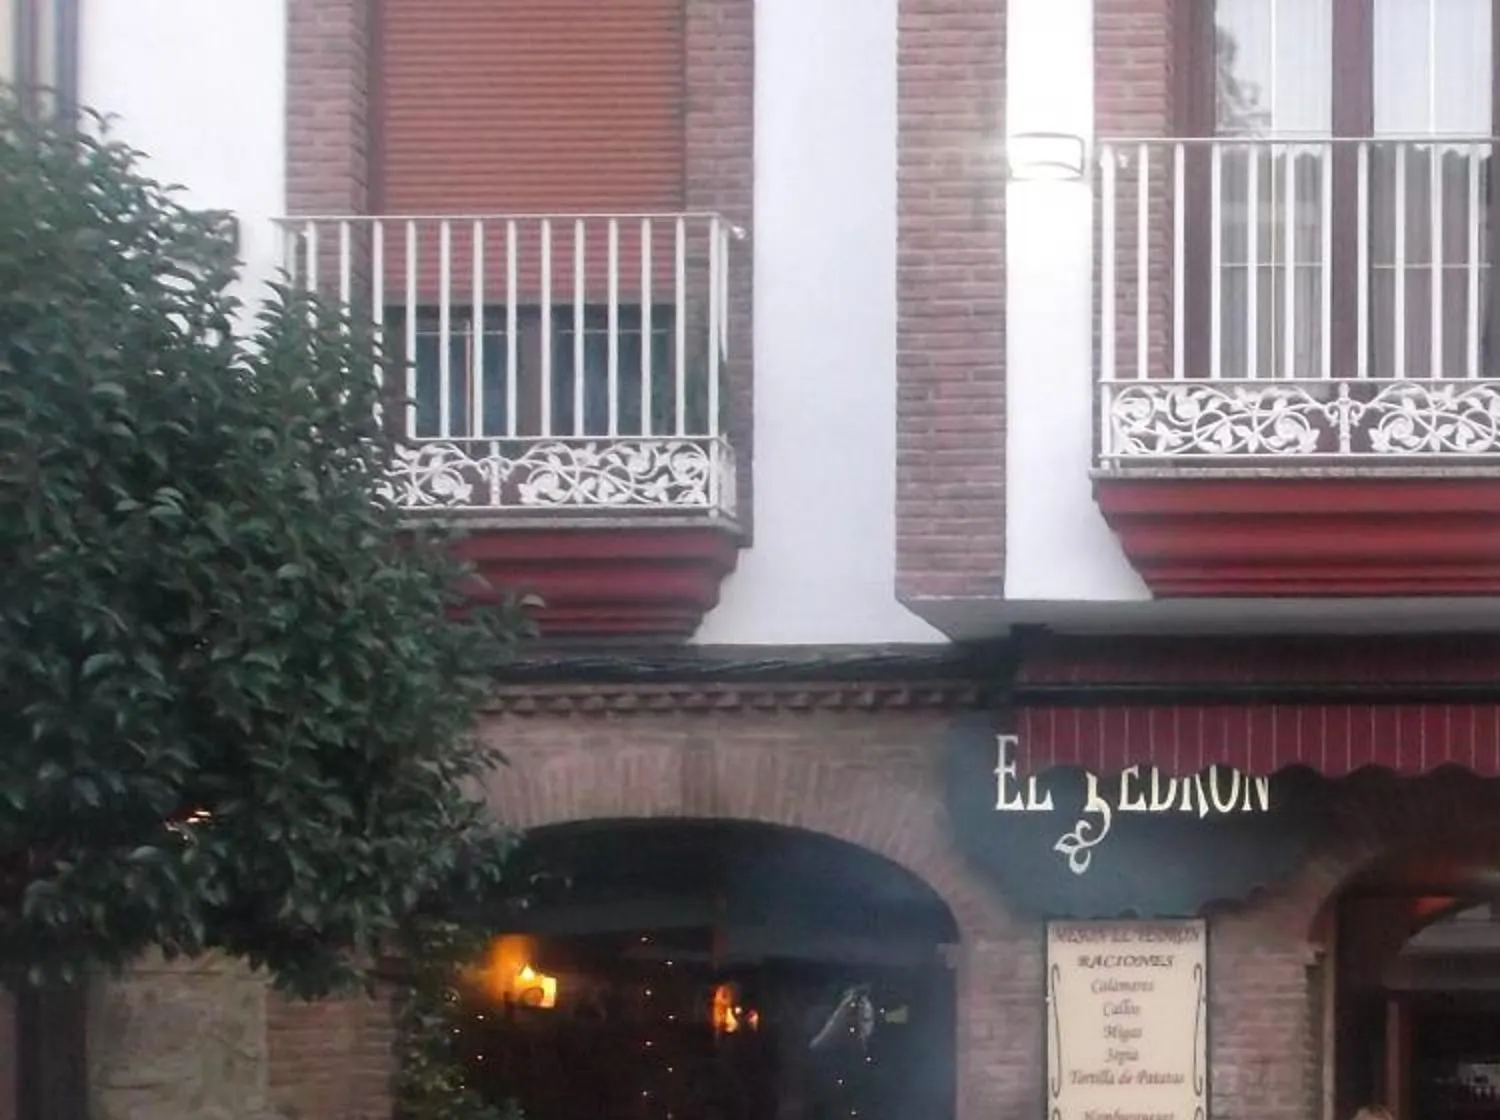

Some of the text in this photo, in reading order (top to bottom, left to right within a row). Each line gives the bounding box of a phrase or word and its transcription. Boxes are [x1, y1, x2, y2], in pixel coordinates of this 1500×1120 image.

[1077, 954, 1176, 968] RACIONES
[1091, 978, 1154, 994] Calamares
[1069, 1069, 1115, 1085] Tortilla
[1117, 1069, 1132, 1085] de
